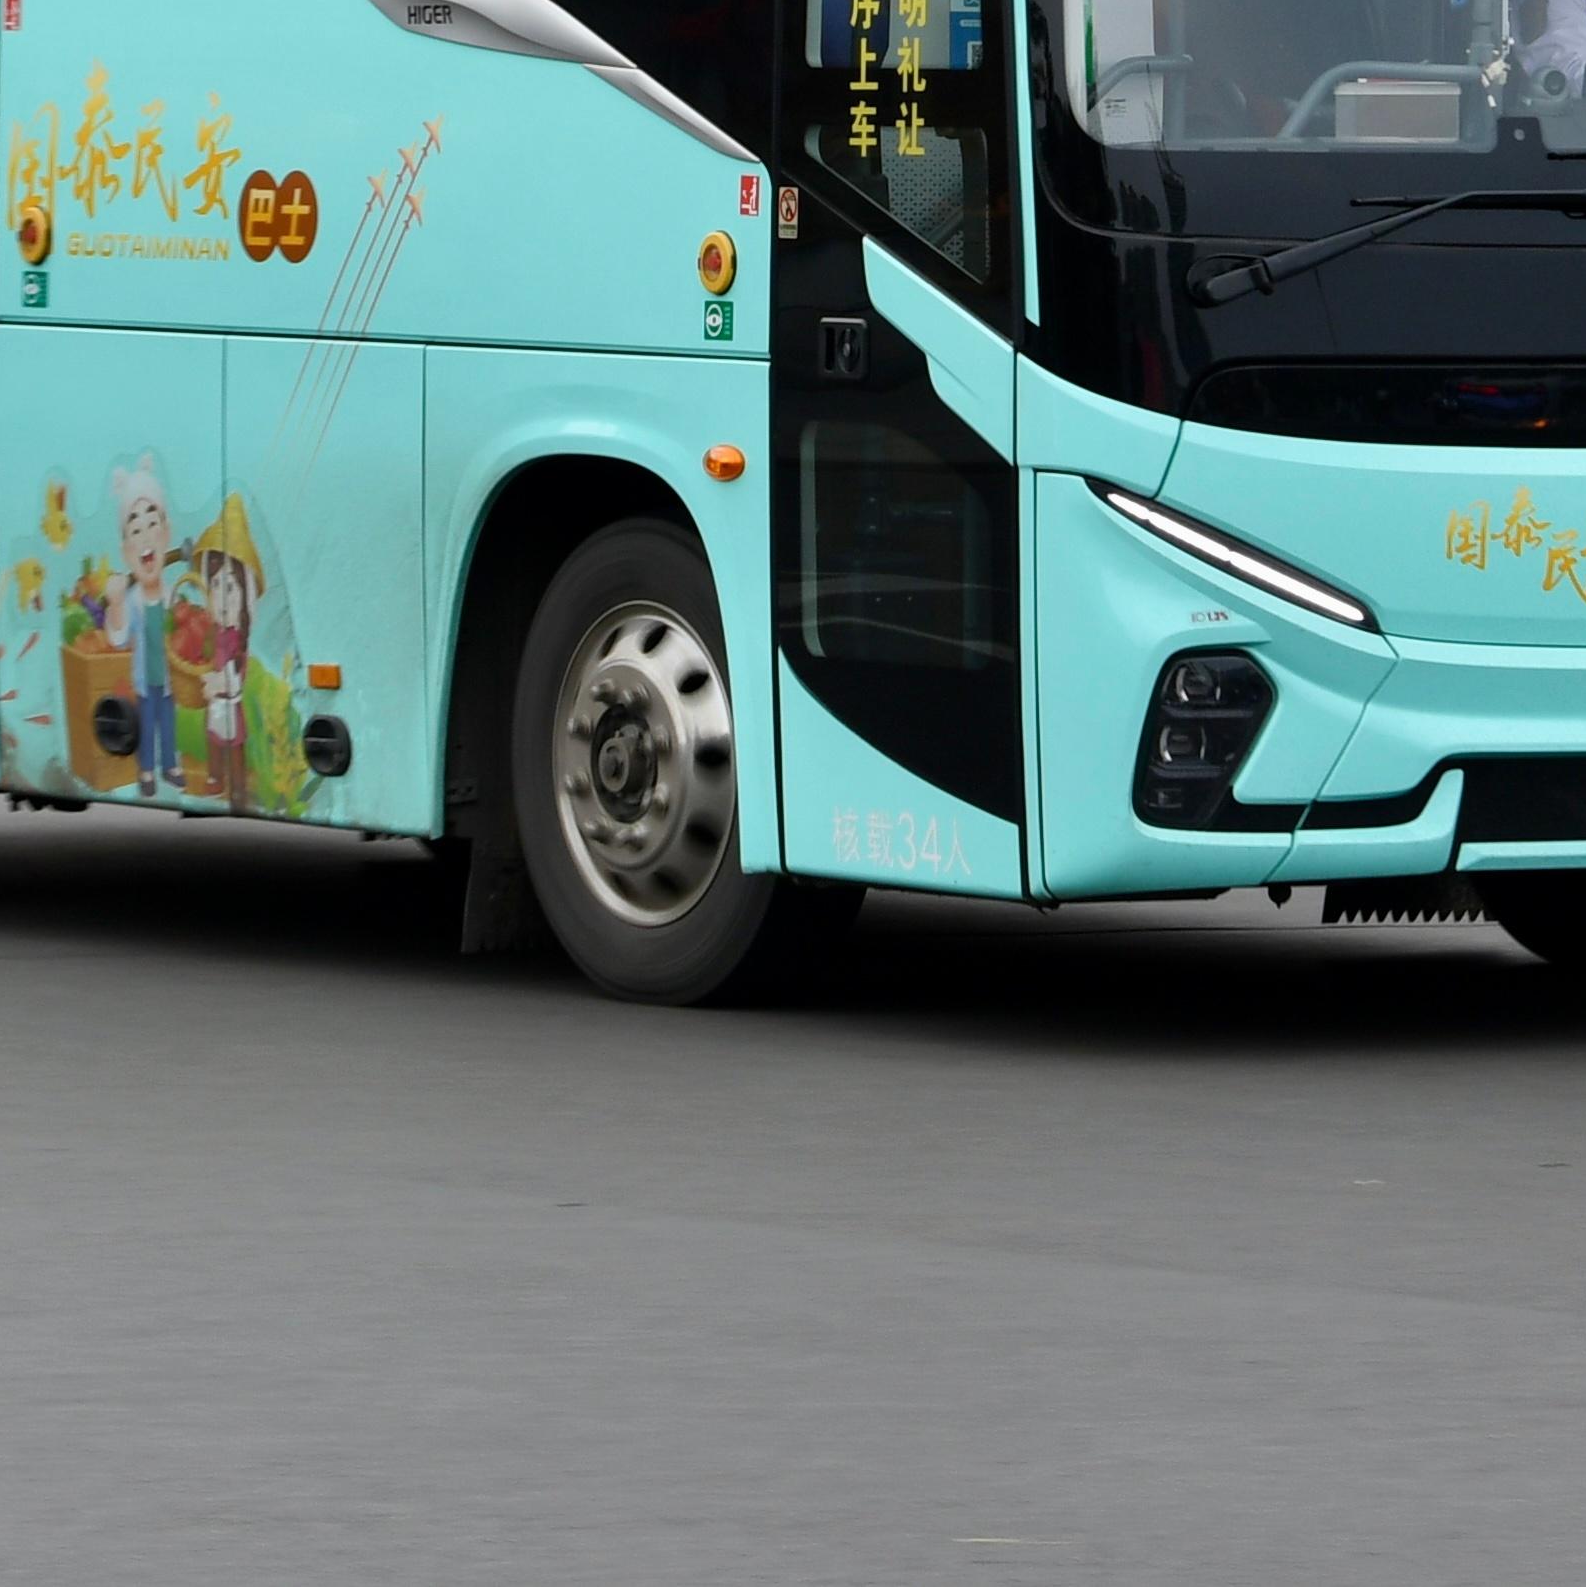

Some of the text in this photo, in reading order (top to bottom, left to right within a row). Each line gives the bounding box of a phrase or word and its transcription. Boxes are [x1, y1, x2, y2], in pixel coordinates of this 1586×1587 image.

[406, 4, 454, 25] HIGER
[245, 187, 311, 247] 巴士
[67, 232, 231, 261] GUOTAIMINAN
[831, 805, 972, 877] 核载34人
